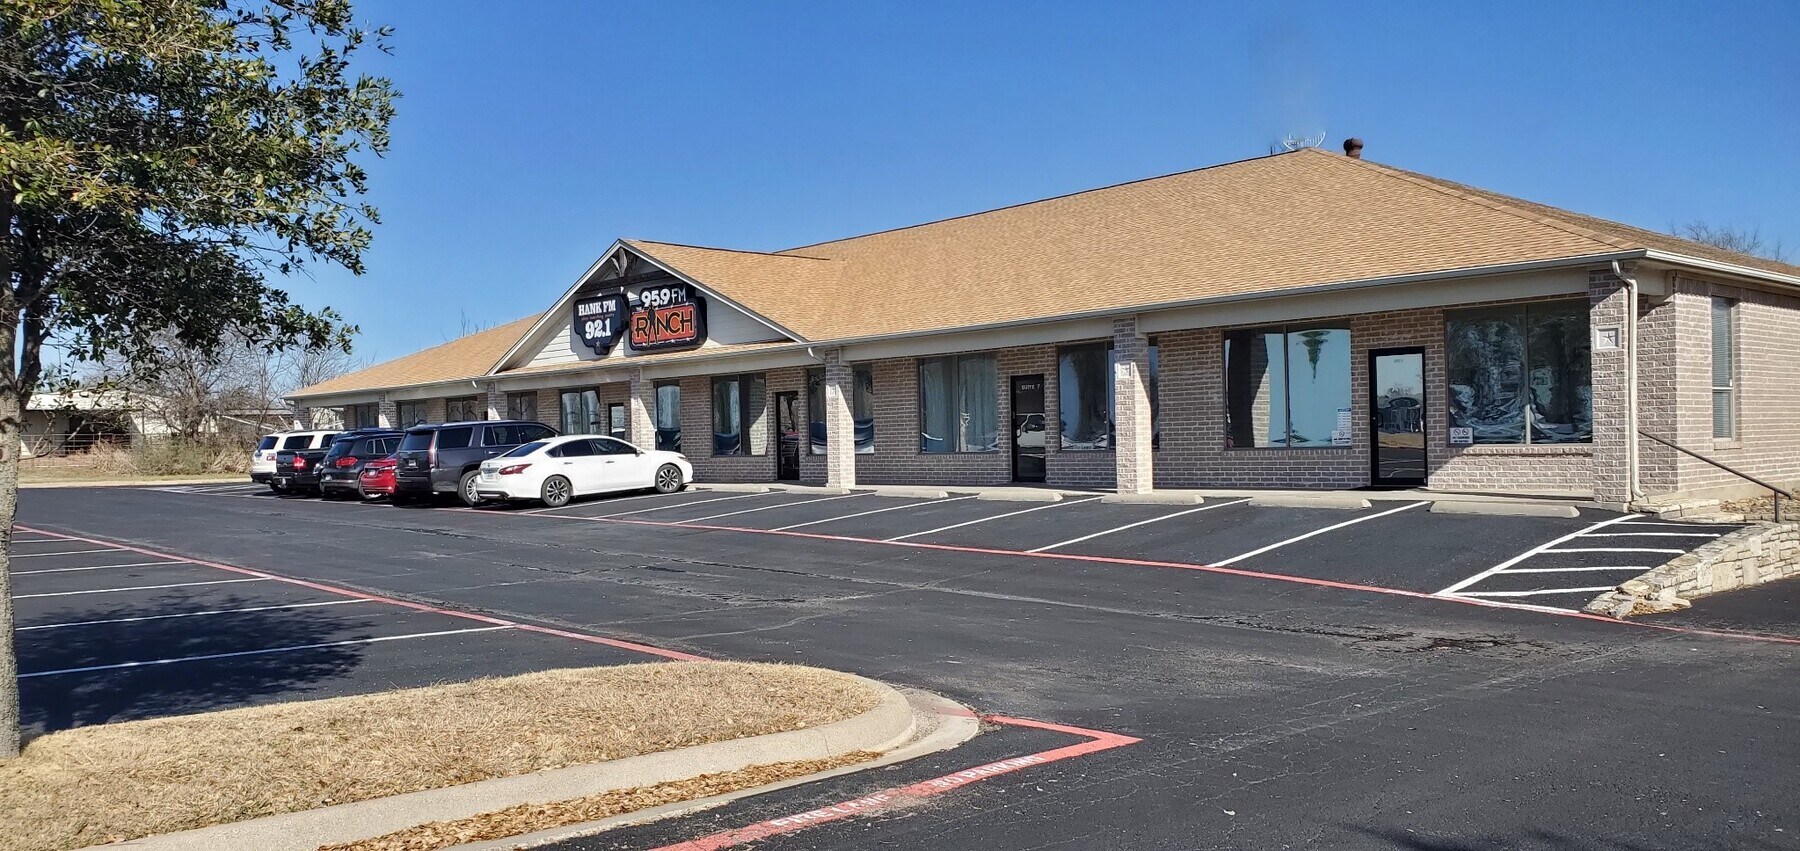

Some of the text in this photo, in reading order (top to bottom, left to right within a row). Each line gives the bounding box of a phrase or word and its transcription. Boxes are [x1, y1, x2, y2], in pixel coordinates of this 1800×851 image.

[578, 299, 616, 316] HANK FM
[641, 286, 687, 307] 95.9 FM
[585, 318, 612, 340] 92.1
[929, 754, 1045, 789] NO PARKING
[770, 794, 891, 827] FIRE LANE
